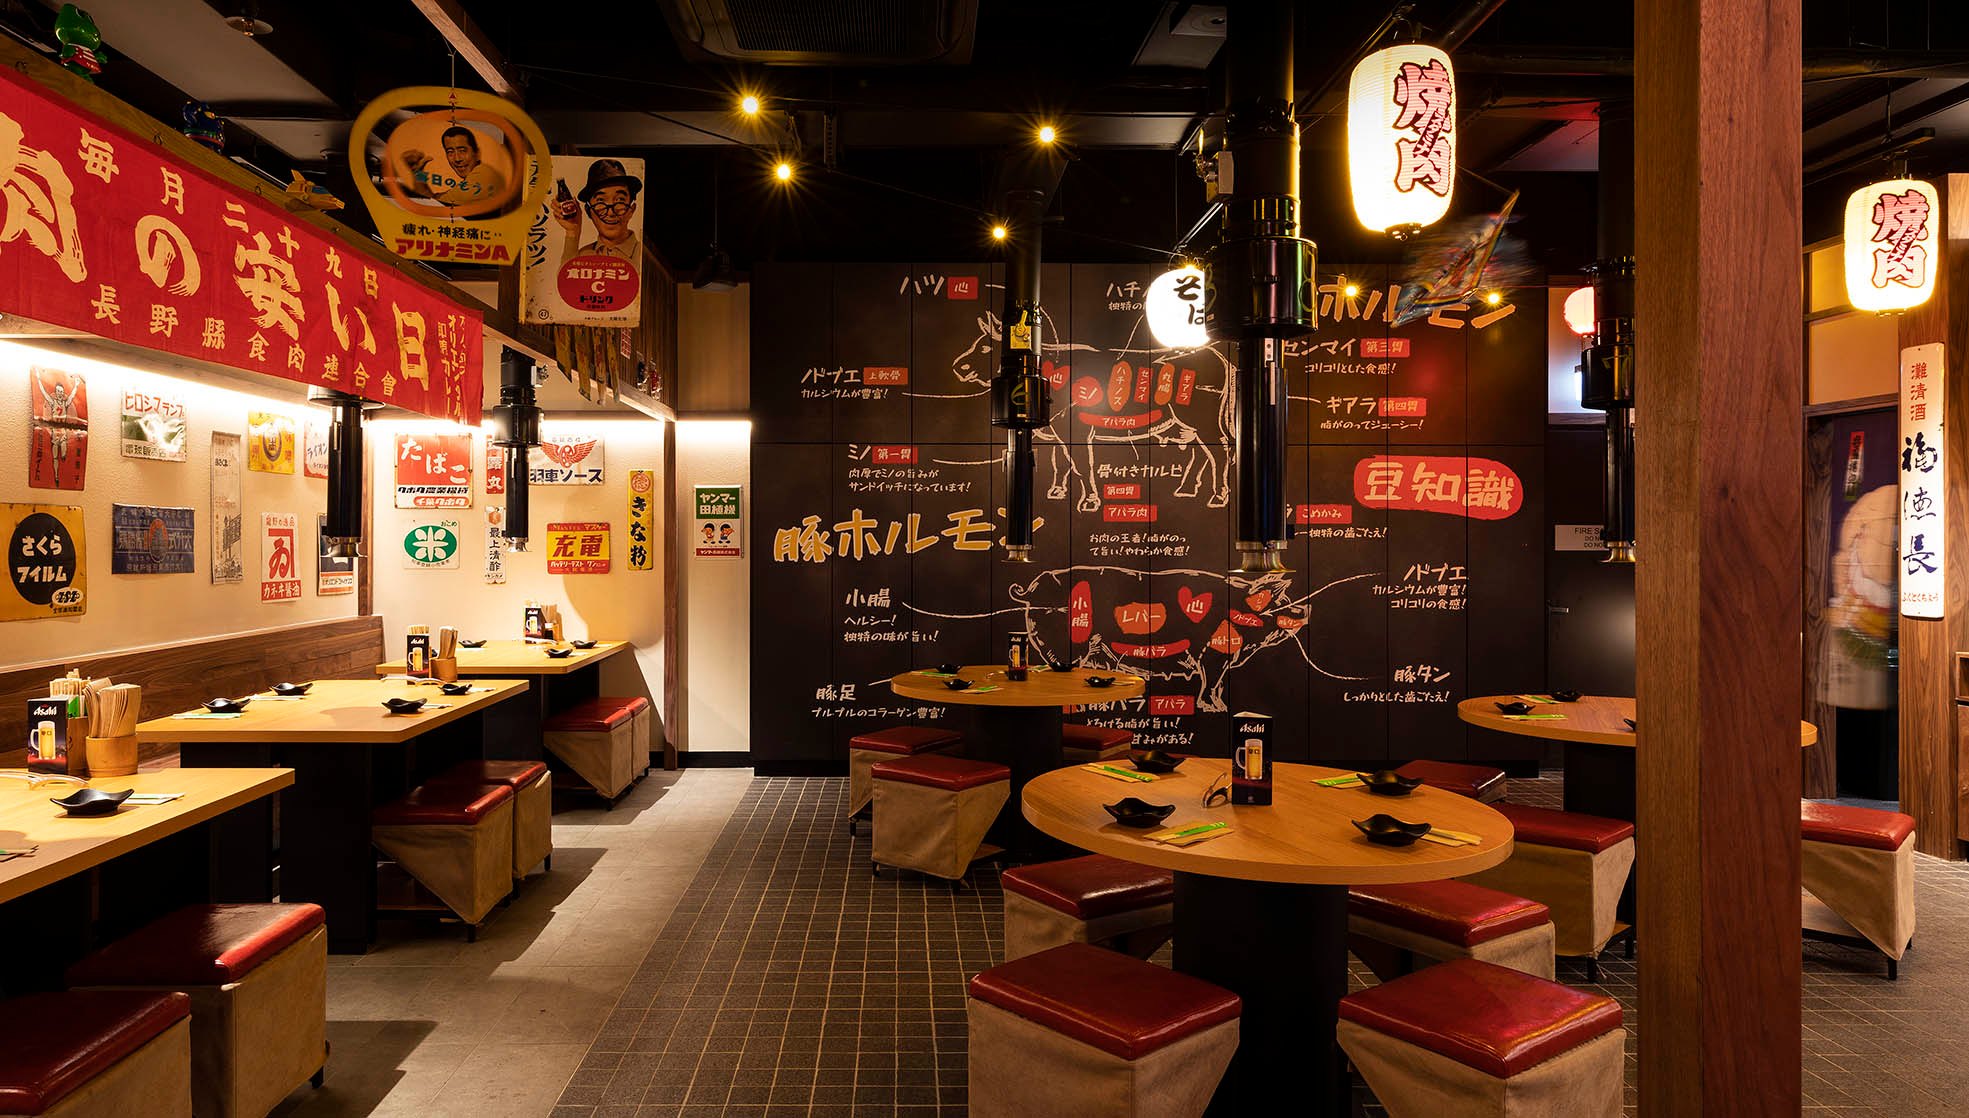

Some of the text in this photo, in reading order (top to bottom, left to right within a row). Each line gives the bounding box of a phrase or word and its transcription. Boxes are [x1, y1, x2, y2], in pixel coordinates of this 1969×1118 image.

[1392, 58, 1452, 197] 焼肉
[78, 128, 379, 300] 毎月二十九日
[1871, 188, 1930, 288] 焼肉
[395, 238, 510, 262] アリナミンA
[566, 268, 630, 281] オロナミン
[591, 281, 606, 294] C
[899, 274, 945, 296] ハツ
[954, 281, 969, 294] 心
[1108, 301, 1146, 312] 独特の
[1284, 337, 1357, 357] センマイ
[1079, 385, 1098, 401] ミノ
[848, 444, 872, 461] ミノ
[401, 439, 467, 484] たばこ
[530, 468, 603, 483] 羽車ソース
[1097, 464, 1183, 479] 骨付きカルビ
[848, 482, 972, 493] サンドイッチになっています!
[1363, 461, 1517, 511] 豆知識
[699, 493, 737, 504] ヤンマー
[1107, 507, 1148, 518] アバラ肉
[1302, 508, 1342, 519] こめかみ
[630, 496, 648, 567] きな粉
[1574, 527, 1592, 535] FIRE
[22, 535, 62, 557] さくら
[552, 534, 603, 558] 充電
[17, 565, 67, 583] フイルム
[846, 588, 891, 608] 小腸
[1186, 599, 1204, 613] 心
[844, 615, 897, 626] ヘルシー!
[1122, 611, 1161, 623] レバー
[843, 630, 940, 643] 独特の味が旨い!
[1394, 665, 1451, 683] 豚タン
[816, 684, 857, 701] 豚足
[1343, 691, 1451, 703] しっかりとした歯ごたえ!
[33, 706, 58, 716] Asahi
[1155, 699, 1186, 710] アバラ
[1239, 723, 1265, 733] Asahi
[1131, 733, 1194, 745] 甘みがある!
